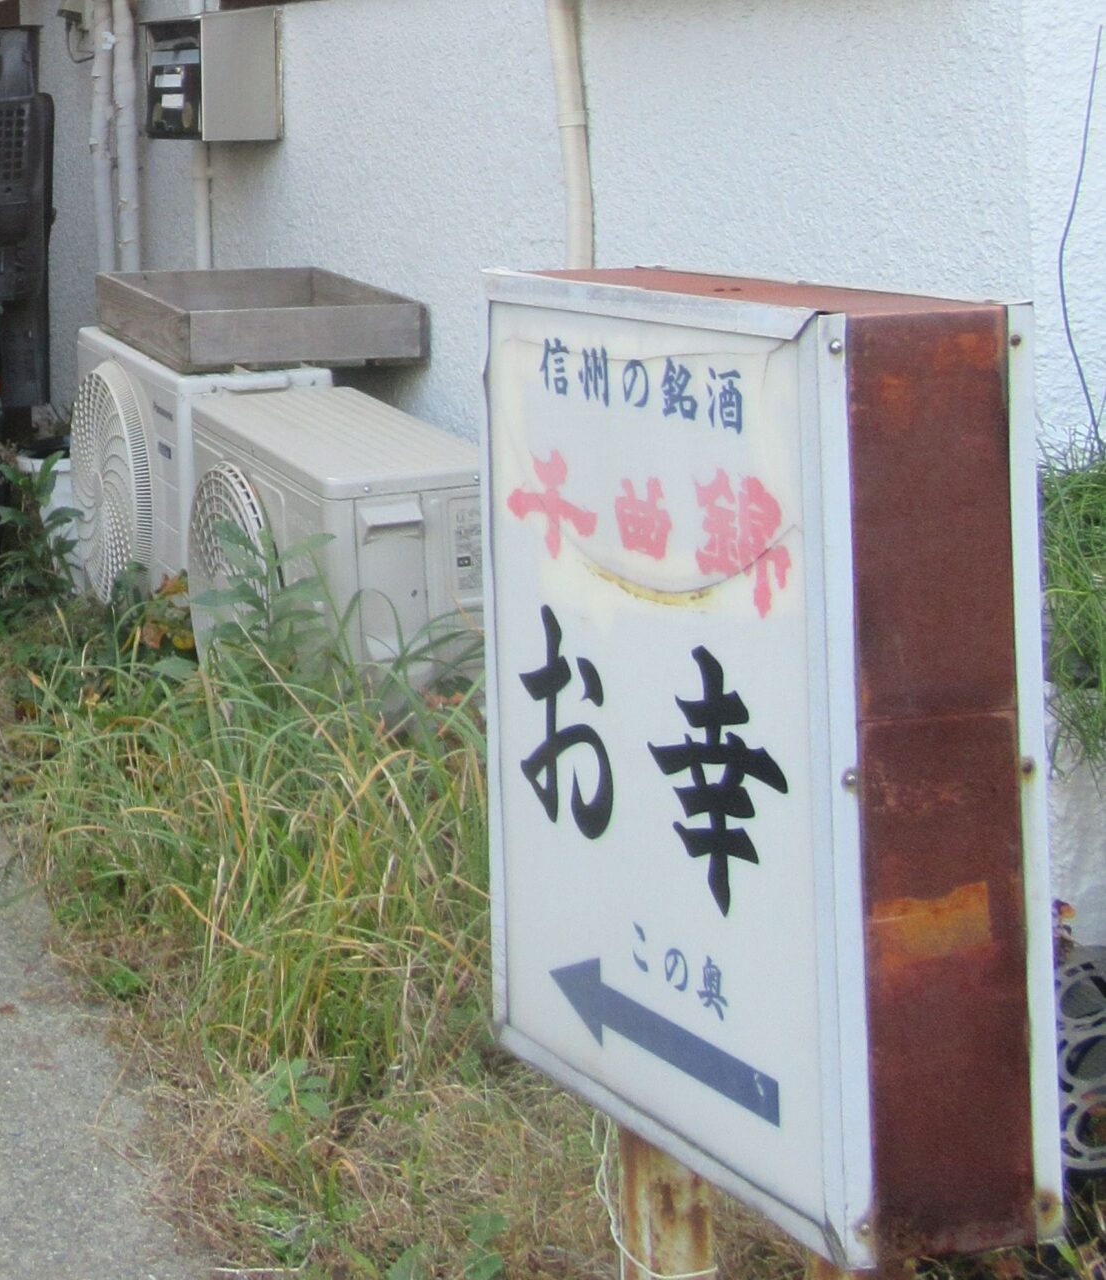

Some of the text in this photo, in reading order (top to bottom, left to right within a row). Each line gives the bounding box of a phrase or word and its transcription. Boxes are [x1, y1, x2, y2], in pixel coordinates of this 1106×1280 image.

[539, 337, 743, 435] 信州の銘酒
[506, 448, 792, 619] 千曲錦
[519, 604, 789, 918] お幸
[632, 921, 729, 1021] この奥
